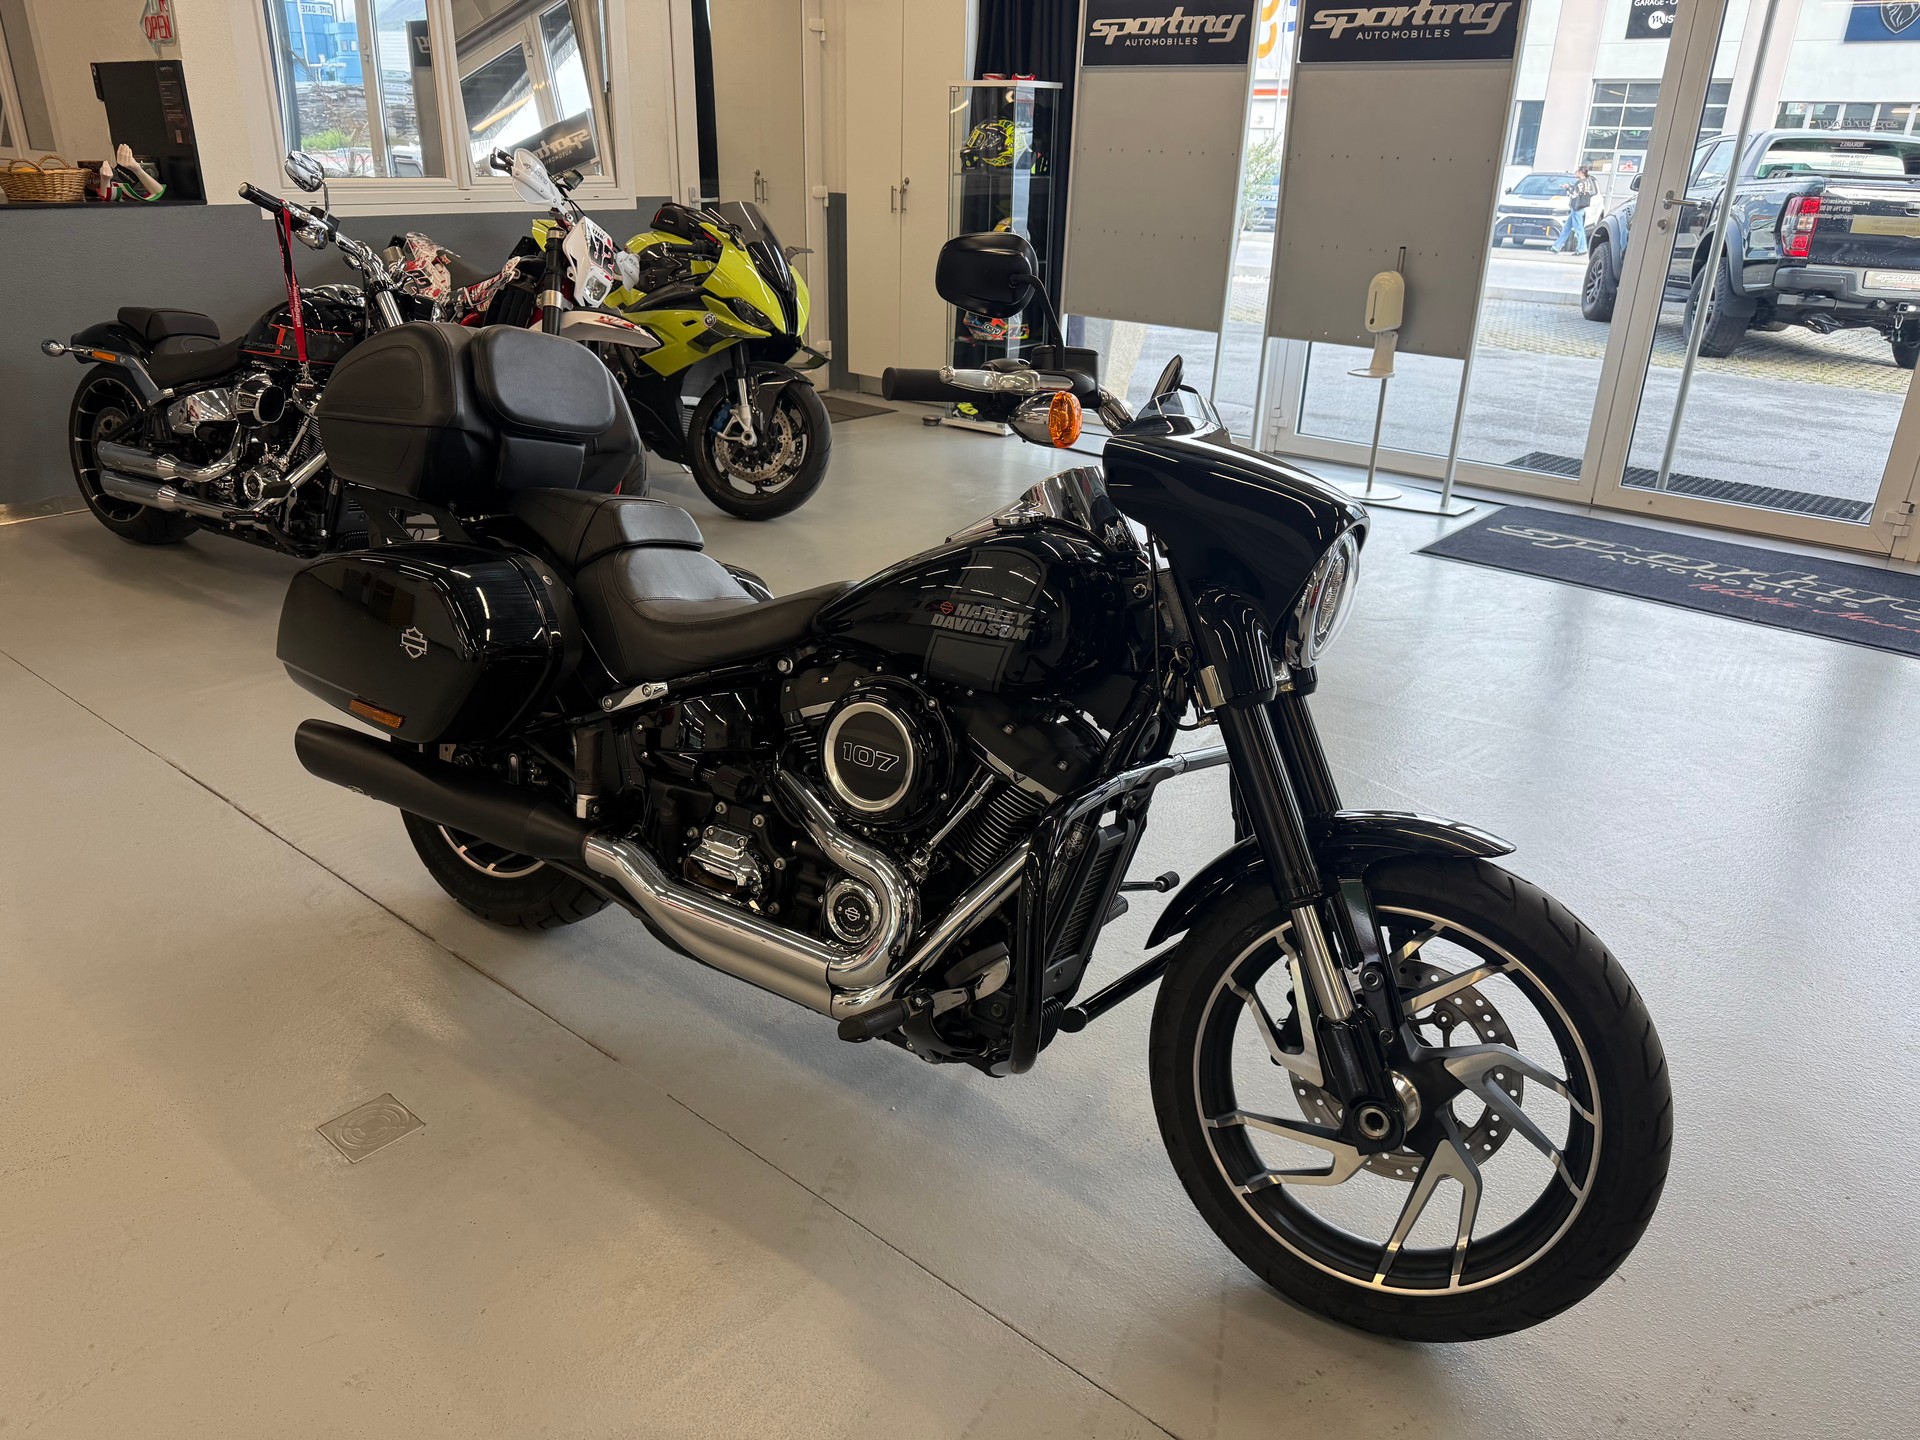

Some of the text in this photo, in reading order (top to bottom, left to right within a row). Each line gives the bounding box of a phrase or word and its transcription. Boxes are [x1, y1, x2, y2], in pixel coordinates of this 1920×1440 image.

[145, 15, 172, 39] OPEN
[1089, 6, 1246, 45] sporting
[1309, 0, 1512, 39] sporting
[1124, 37, 1198, 46] AUTOMOBILES
[1356, 29, 1451, 40] AUTOMOBILES
[1597, 554, 1861, 609] AUTOMOBILES
[930, 613, 1032, 641] DAVIDSON
[843, 741, 900, 772] 107
